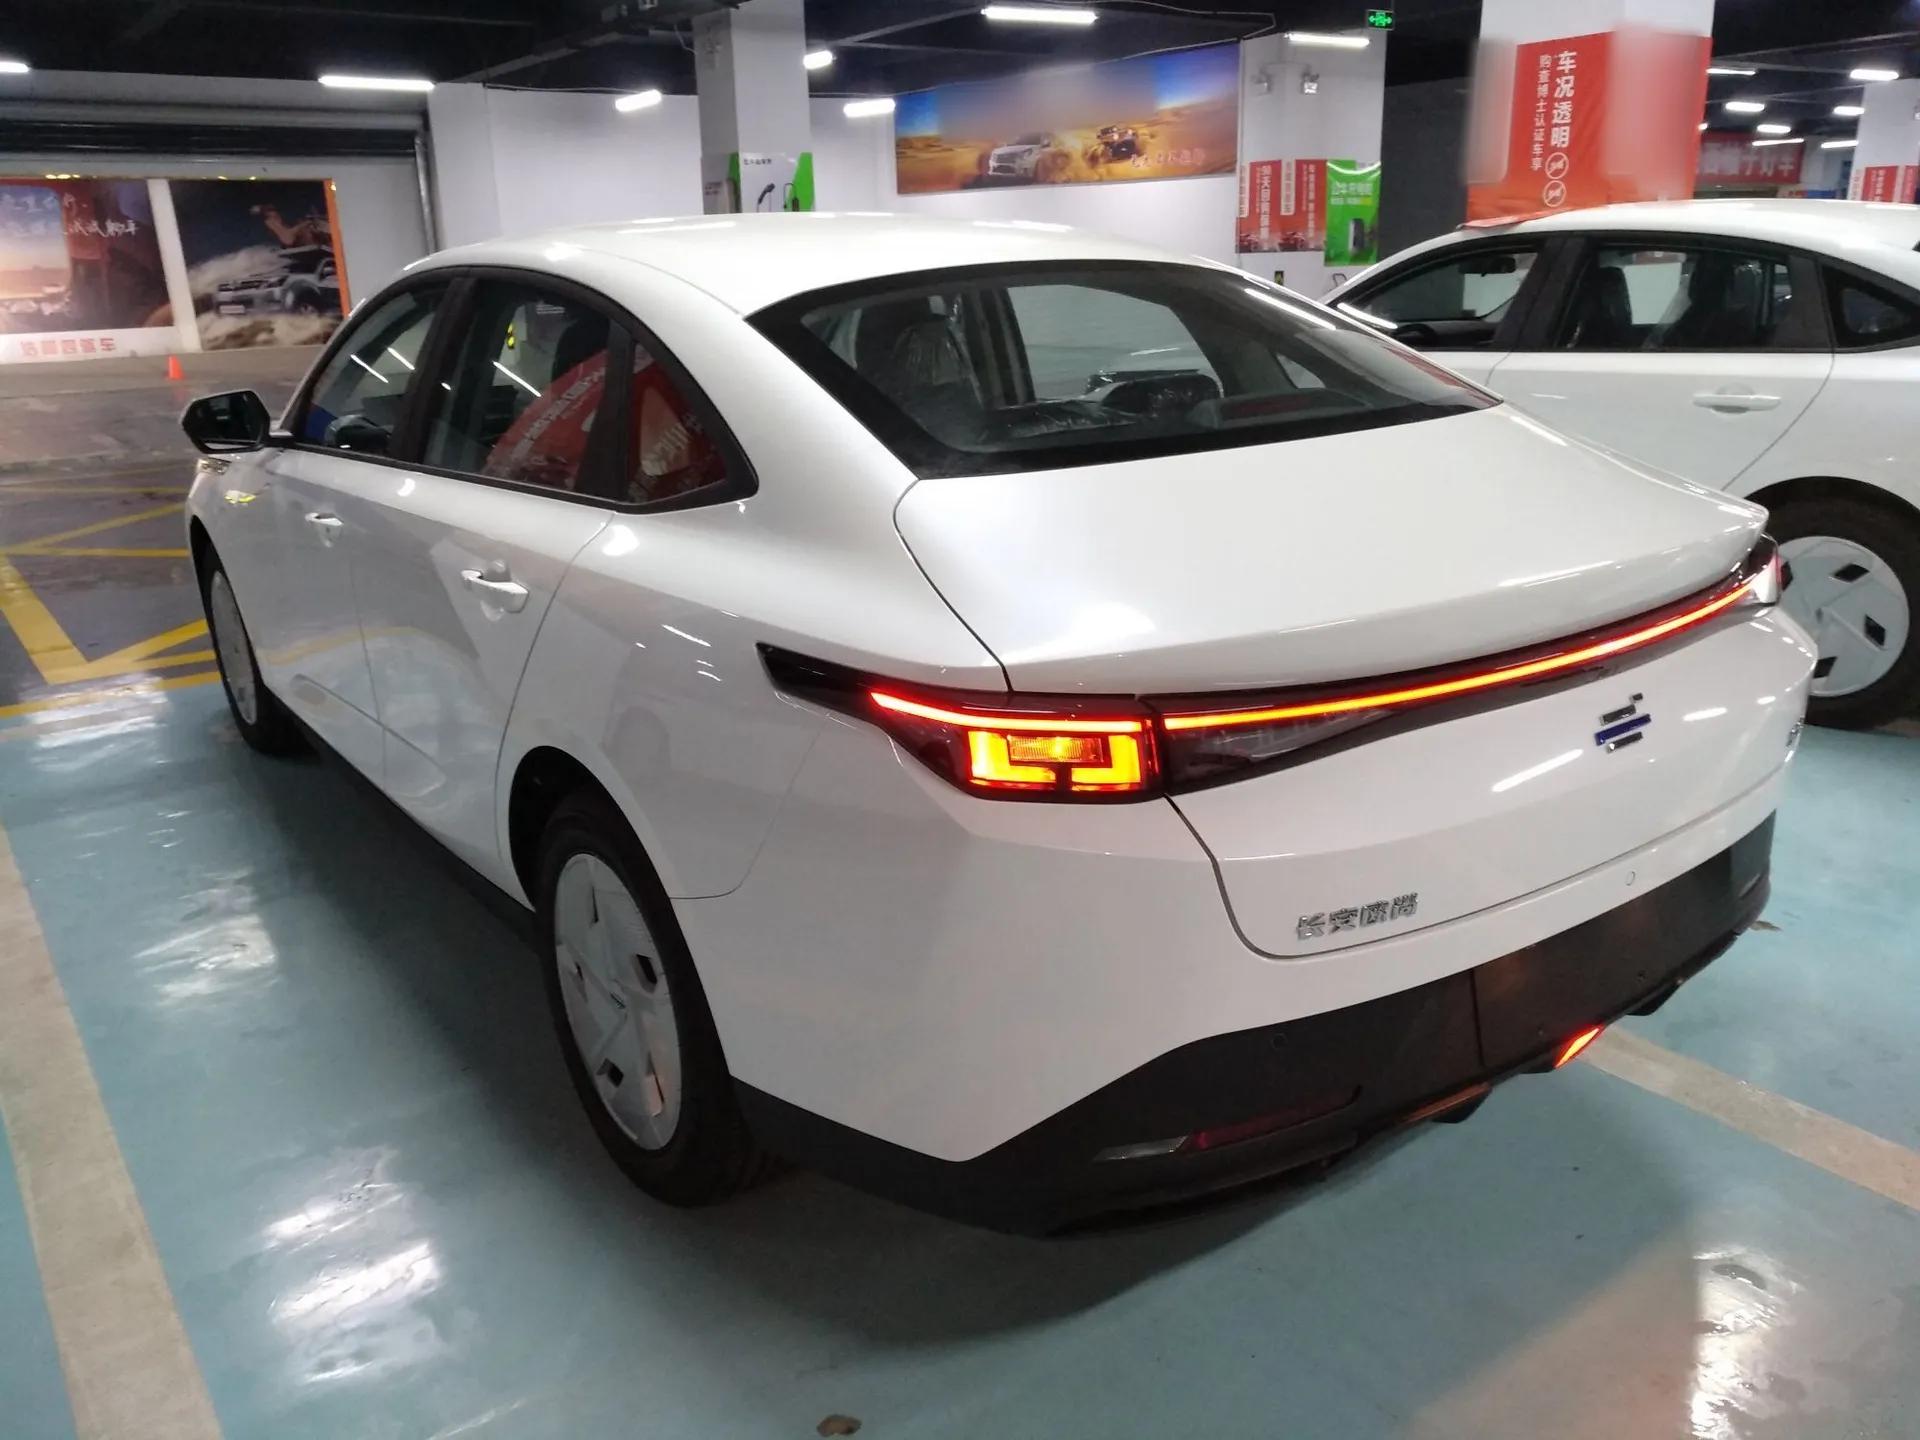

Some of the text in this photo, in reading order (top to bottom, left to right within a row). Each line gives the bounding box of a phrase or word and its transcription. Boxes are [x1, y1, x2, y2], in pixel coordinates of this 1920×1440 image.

[1550, 51, 1577, 148] 车况透明
[1296, 892, 1418, 940] 长安欧尚
